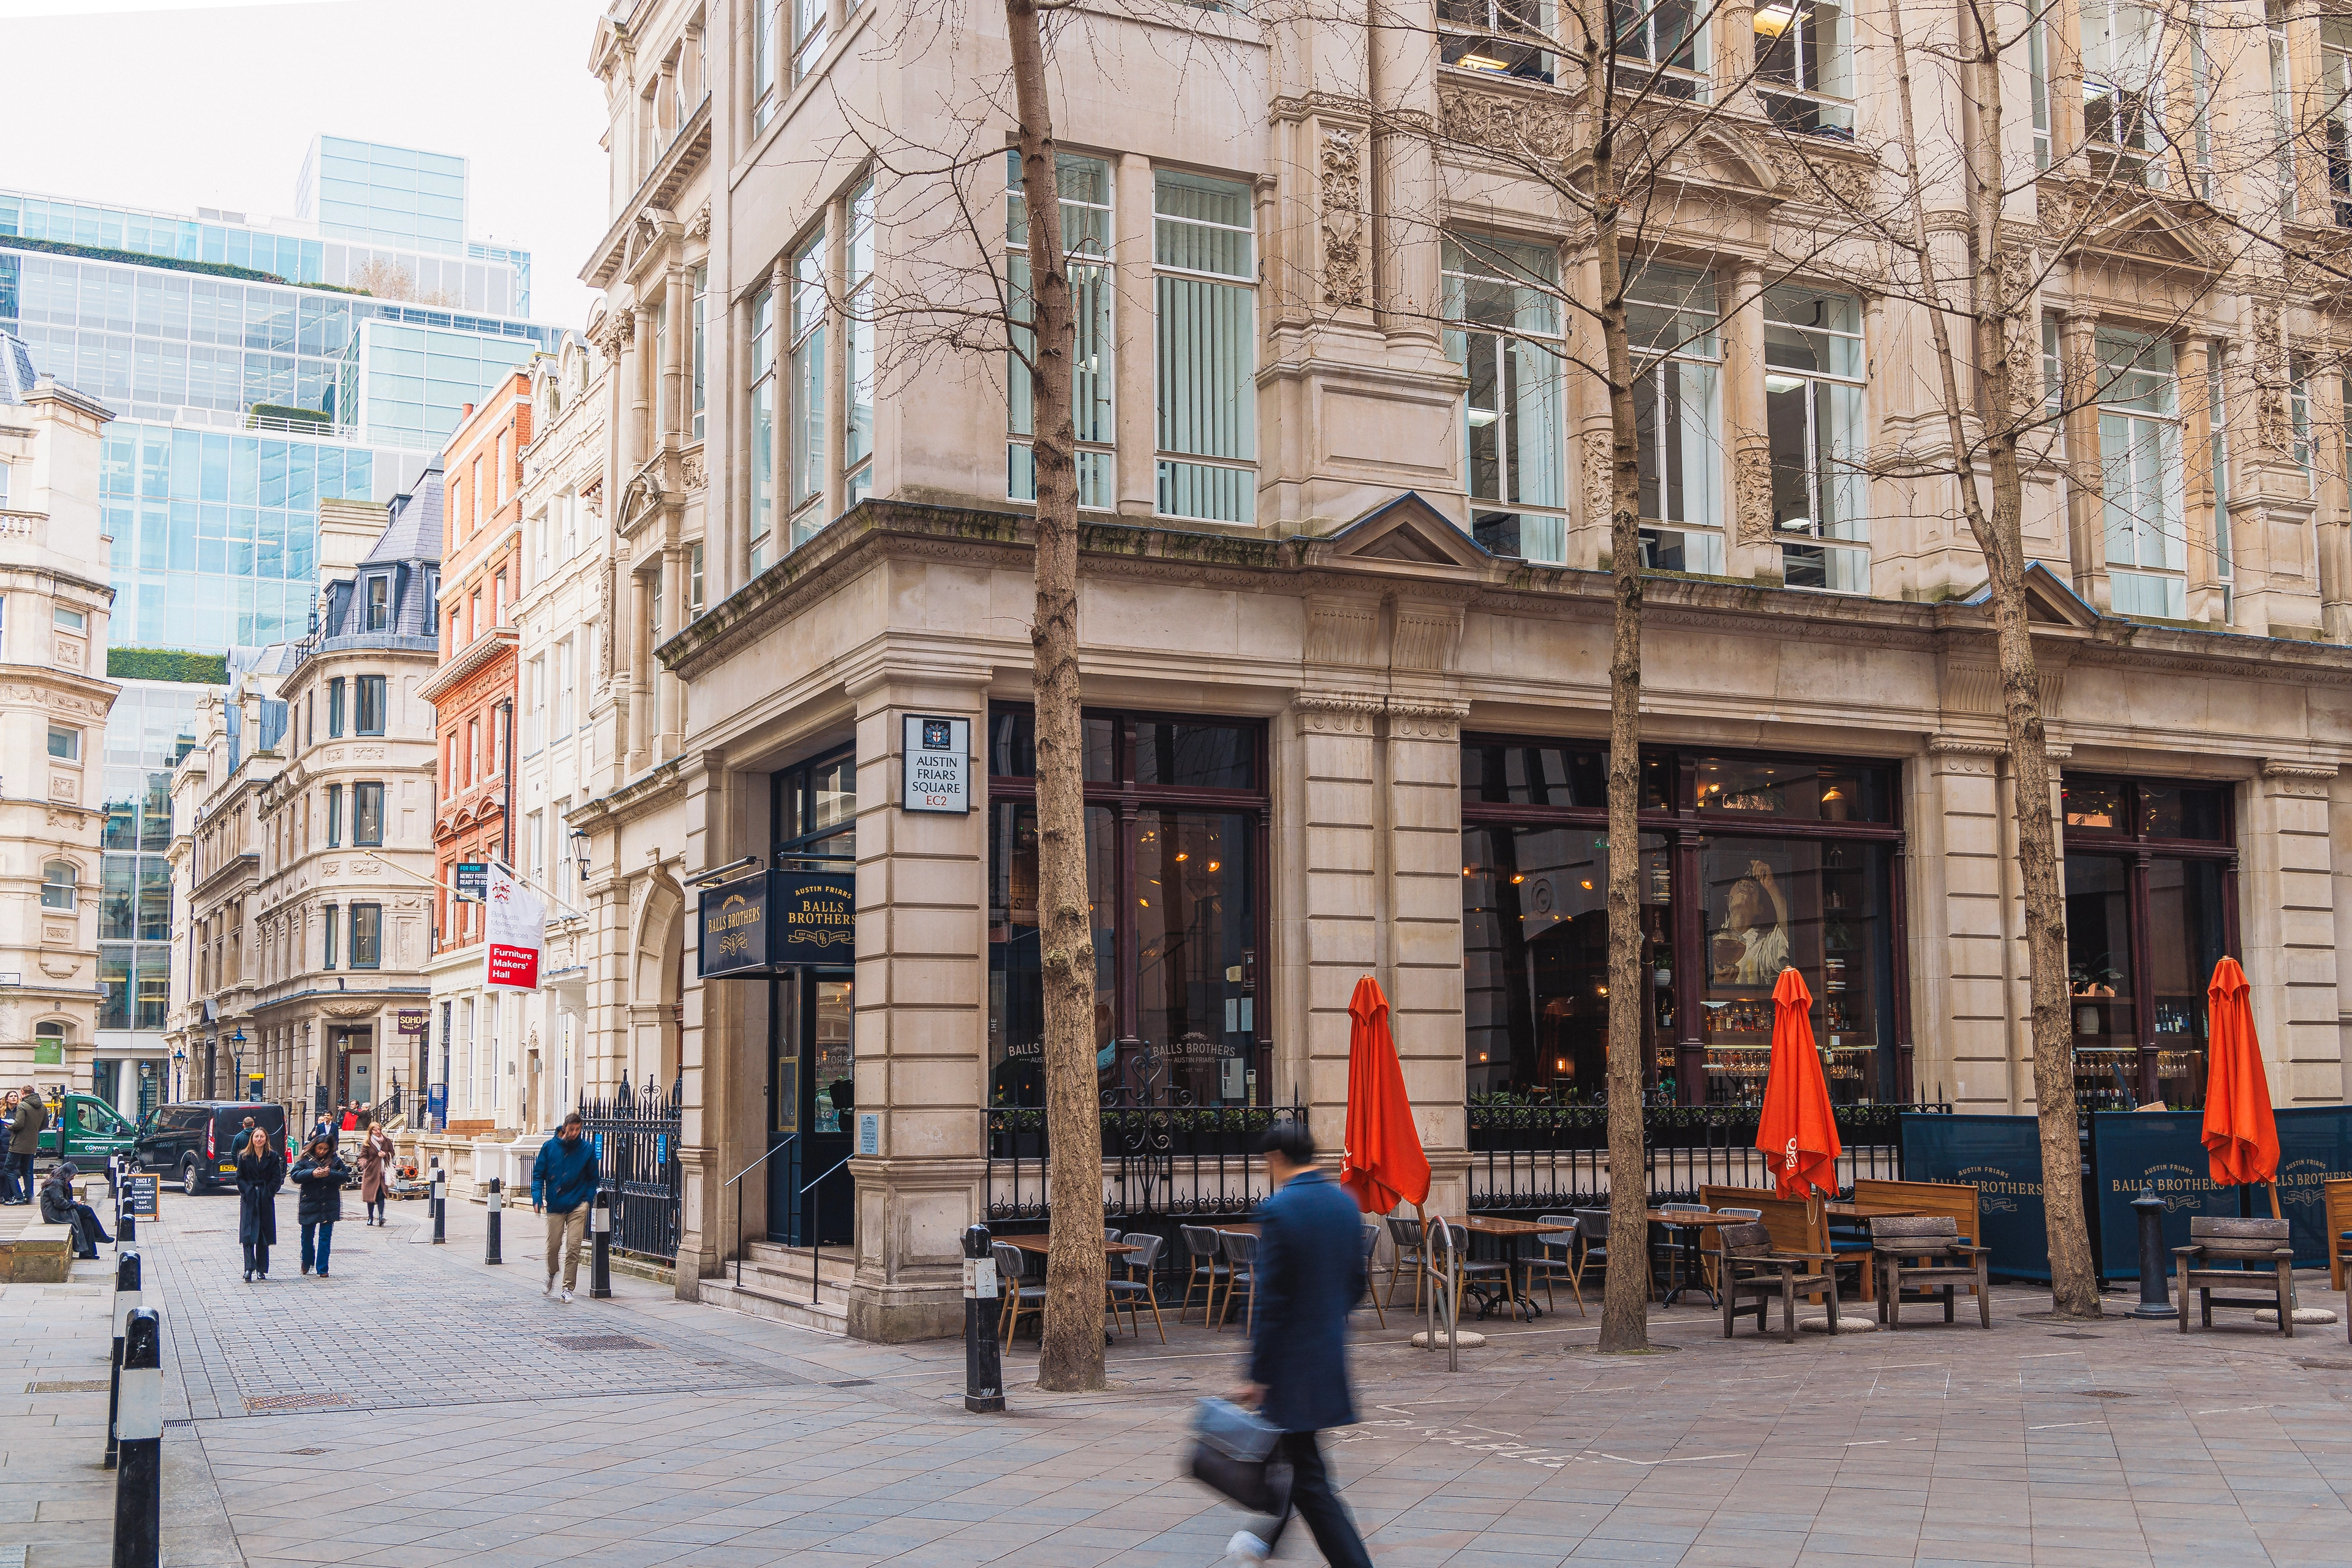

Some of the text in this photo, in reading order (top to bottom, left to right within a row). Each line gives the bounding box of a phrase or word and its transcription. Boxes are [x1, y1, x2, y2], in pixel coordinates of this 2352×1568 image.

[916, 756, 957, 767] AUSTIN
[918, 769, 955, 780] FRIARS
[913, 782, 960, 793] SQUARE
[926, 796, 947, 805] EC2
[795, 886, 851, 899] AUSTIN FRIARS
[723, 895, 745, 911] AUSTIN FRIARS
[803, 901, 843, 913] BALLS
[491, 911, 519, 921] Banquets
[708, 907, 760, 933] BALLS BROTHERS
[788, 912, 856, 924] BROTHERS
[491, 920, 518, 930] Meetings
[490, 929, 529, 939] Conferences
[494, 948, 532, 960] Furniture
[493, 959, 528, 969] Makers’
[1009, 1043, 1039, 1057] BALLS
[1153, 1043, 1235, 1057] BALLS BROTHERS
[2144, 1164, 2193, 1175] AUSTIN FRIARS
[2286, 1159, 2326, 1170] AUSTIN FRIARS
[1958, 1166, 2009, 1178] AUSTIN FRIARS
[2113, 1179, 2152, 1191] BALLS
[2260, 1175, 2293, 1187] LLS
[1972, 1181, 2043, 1195] BROTHERS
